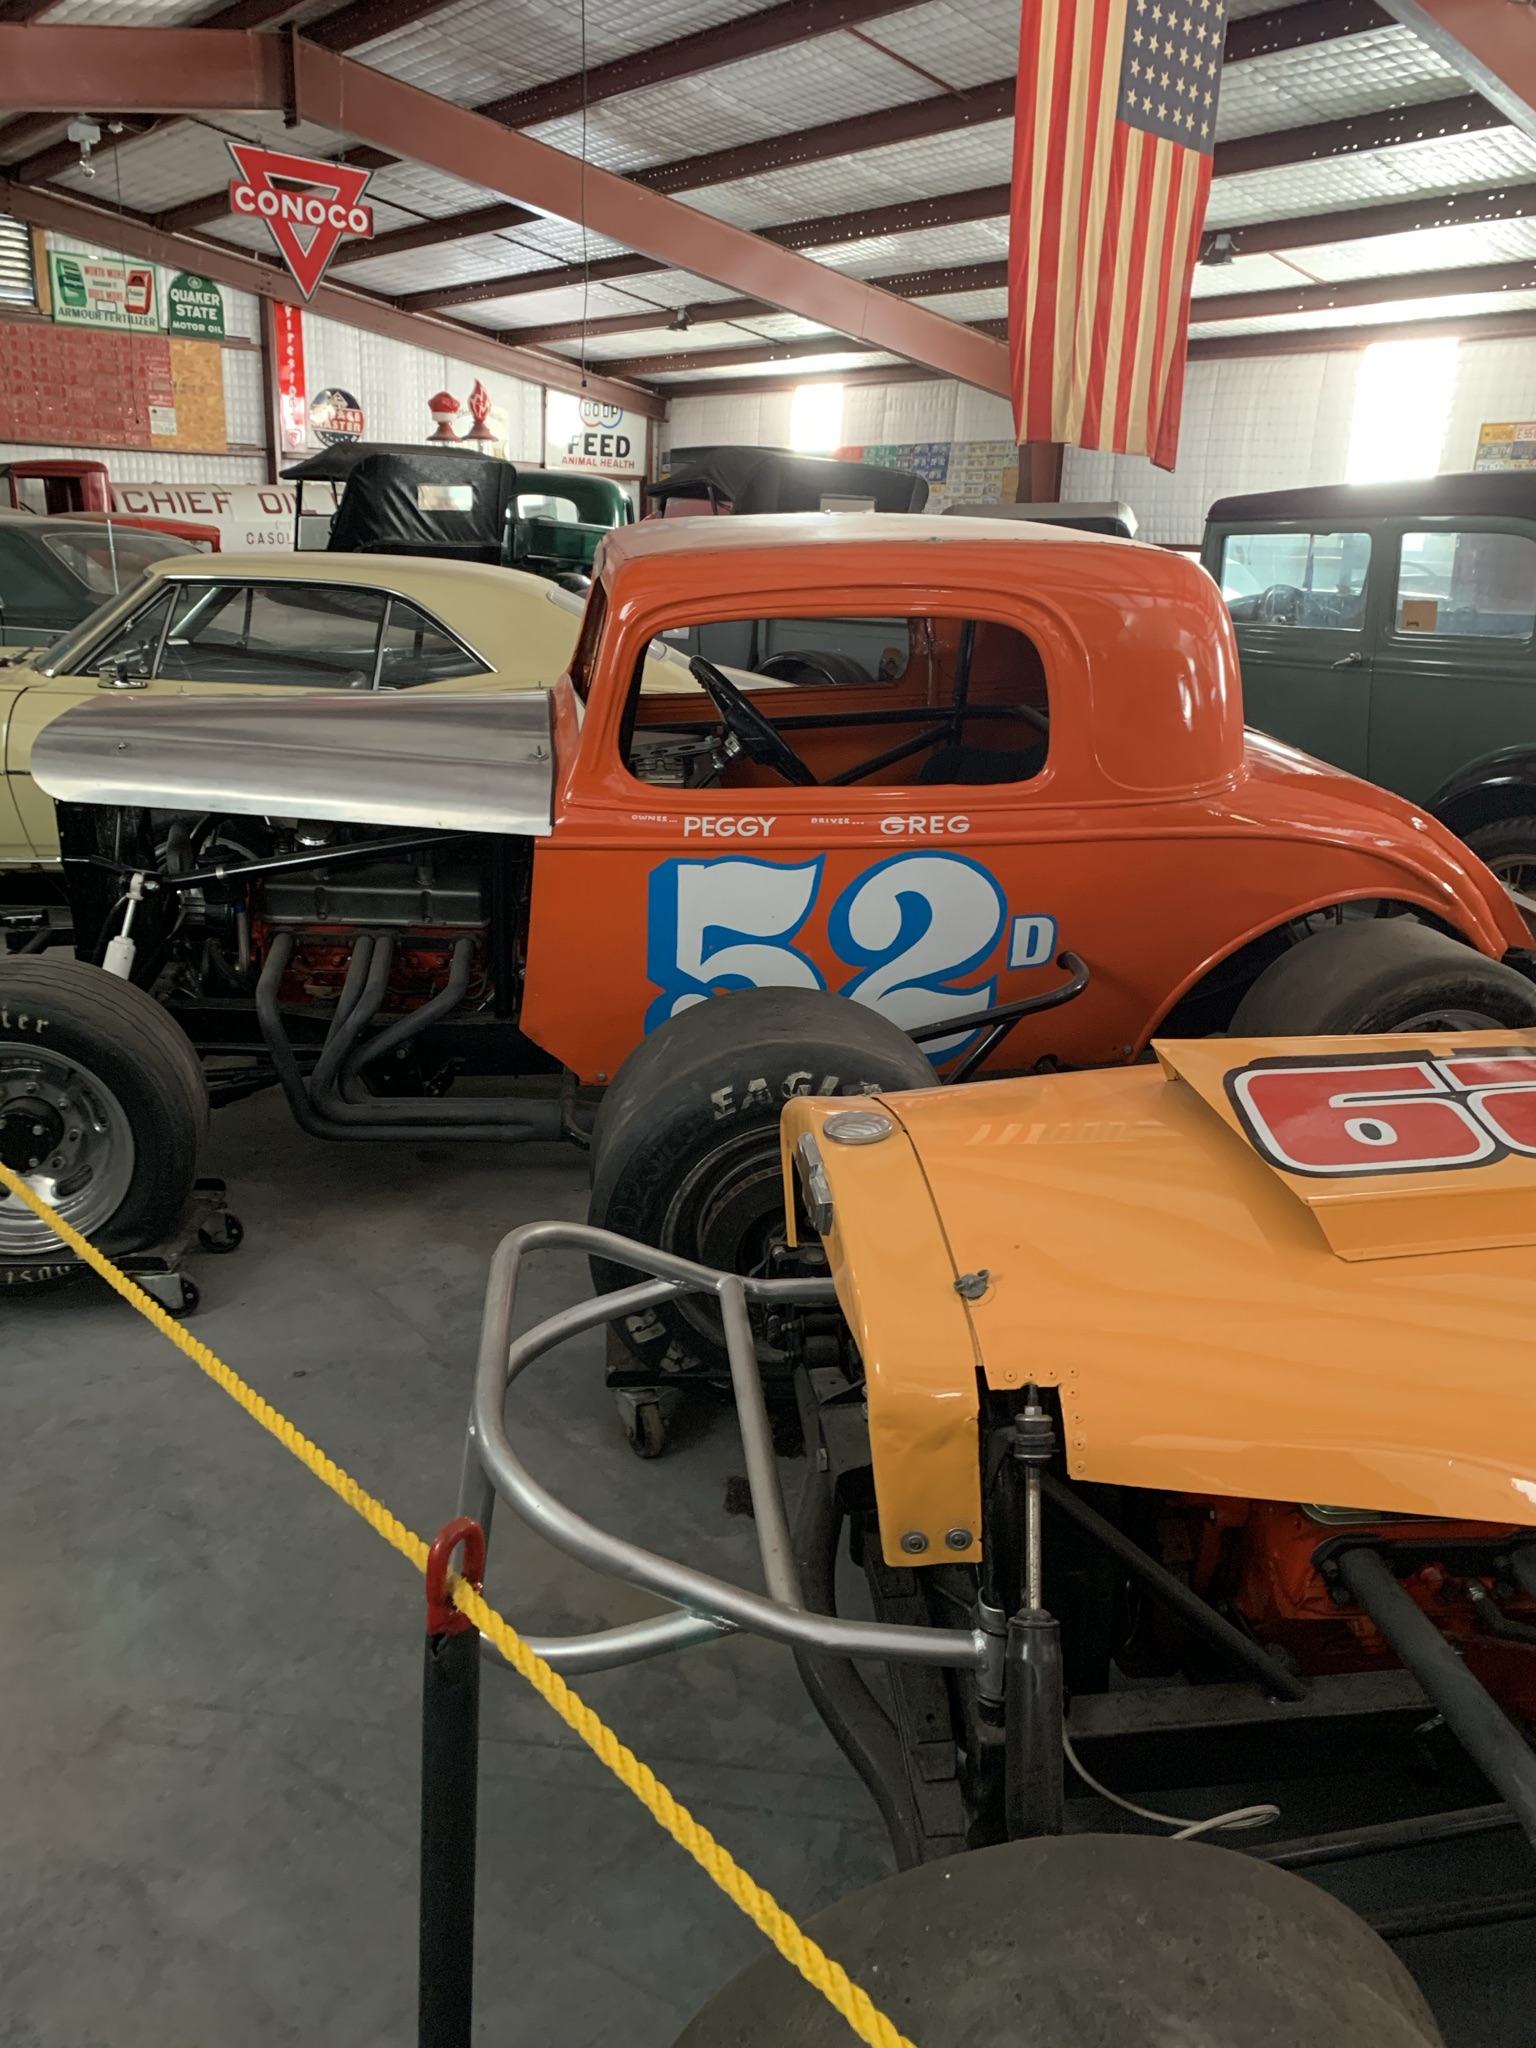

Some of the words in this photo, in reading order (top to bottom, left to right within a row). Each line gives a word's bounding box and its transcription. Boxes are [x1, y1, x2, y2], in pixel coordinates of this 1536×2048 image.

[235, 186, 368, 233] CONOCO
[170, 288, 220, 307] QUAKER
[58, 306, 102, 321] ARMOUR
[104, 312, 155, 327] FERTILIZER
[176, 304, 218, 320] STATE
[172, 320, 206, 332] MOTOR
[207, 325, 223, 334] OIL
[284, 304, 298, 422] Fireston
[567, 433, 631, 458] FEED
[561, 456, 598, 467] ANIMAL
[600, 458, 635, 469] HEALTH
[121, 490, 232, 514] CHIEF
[684, 816, 777, 837] PEGGY
[880, 815, 970, 835] GREG
